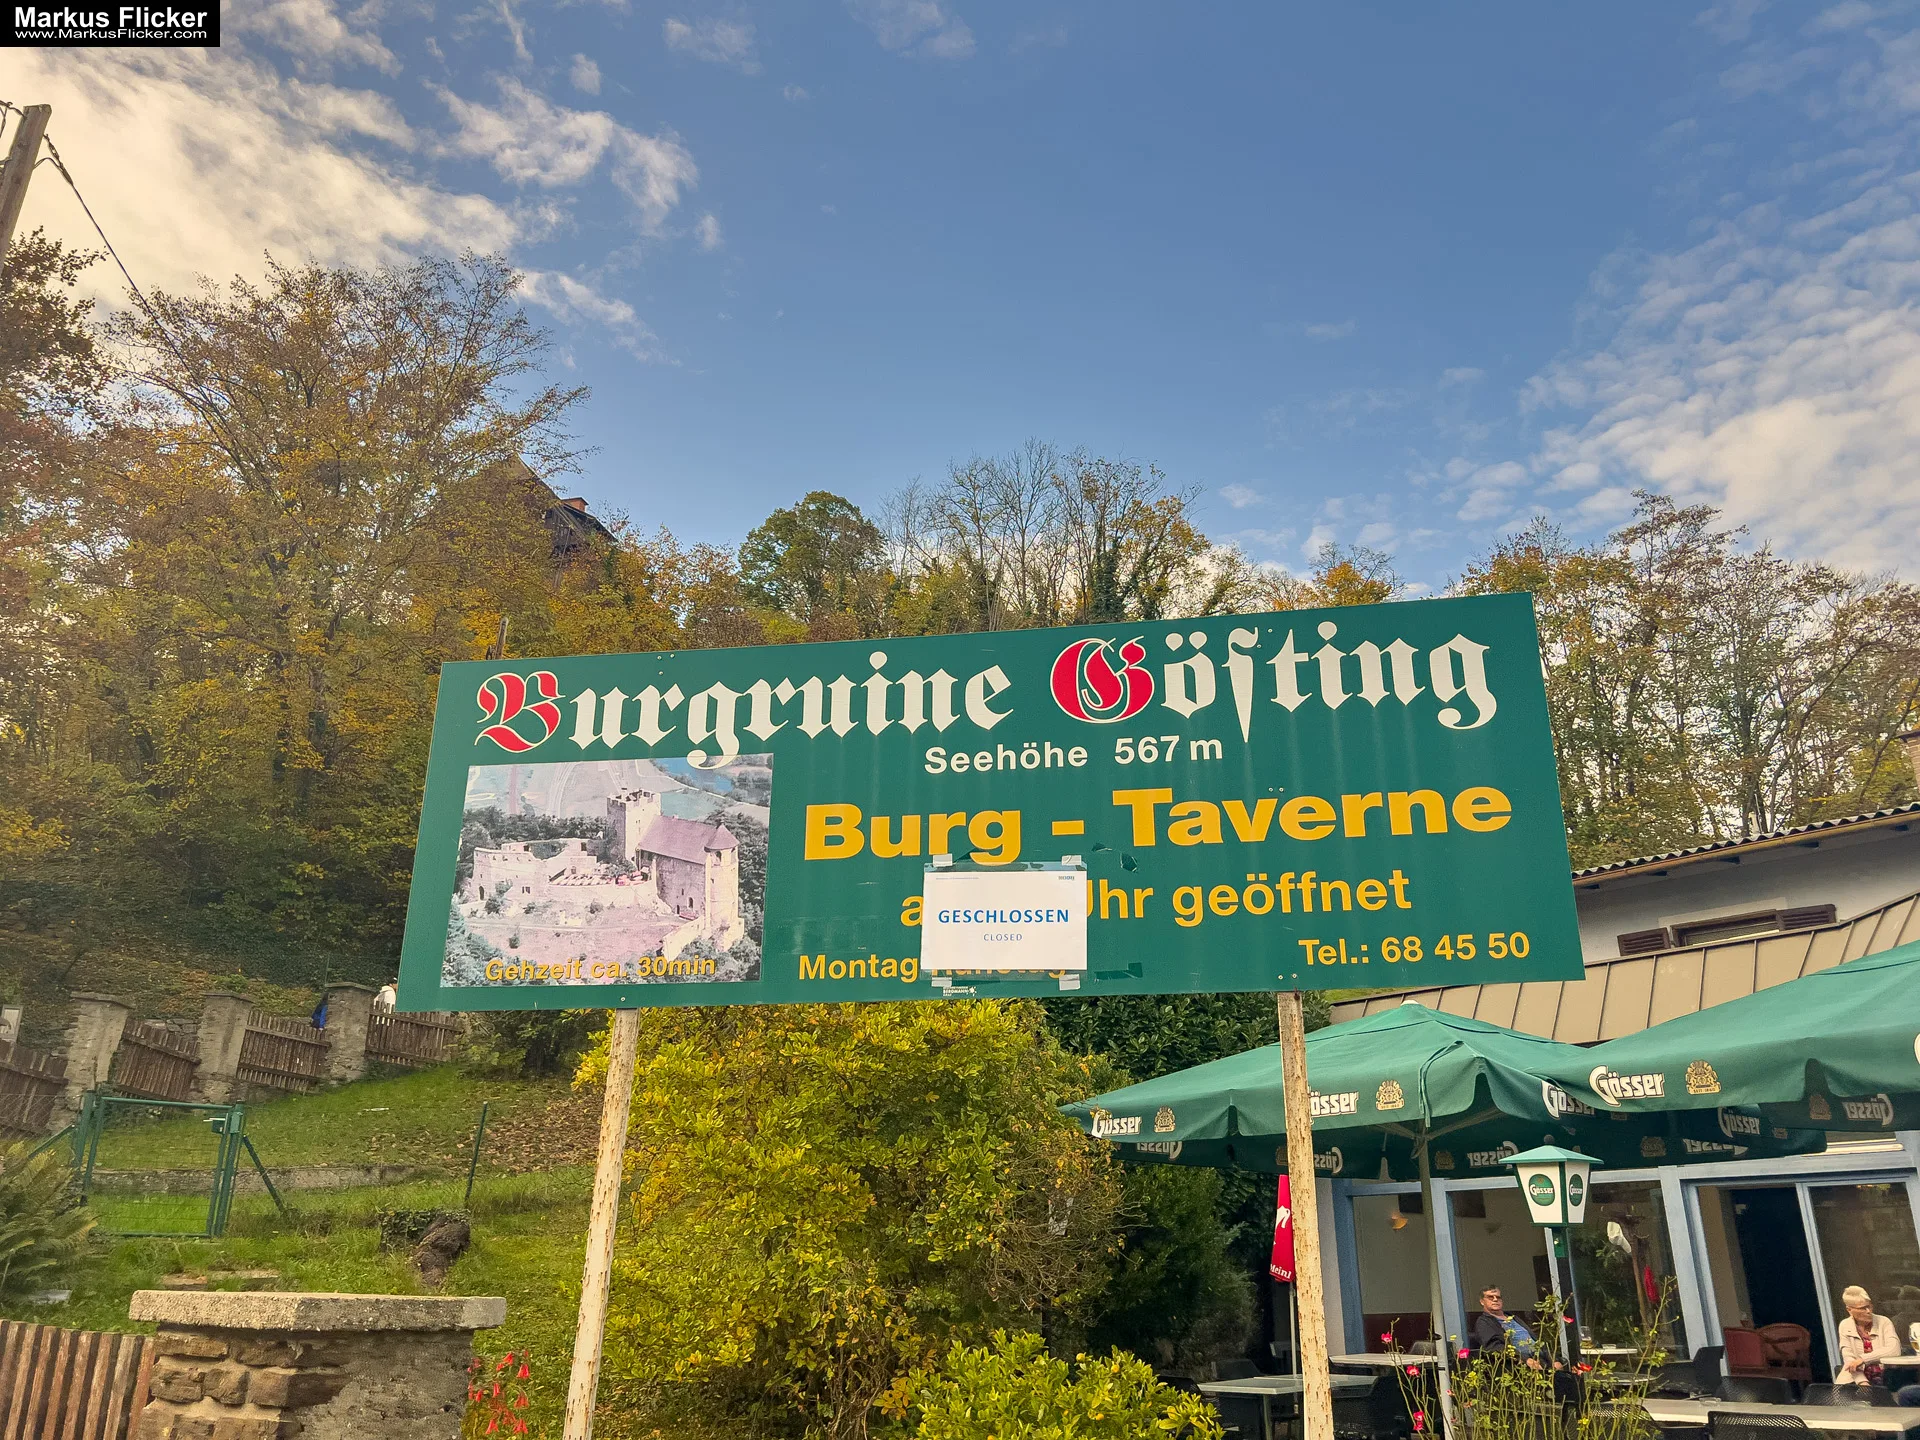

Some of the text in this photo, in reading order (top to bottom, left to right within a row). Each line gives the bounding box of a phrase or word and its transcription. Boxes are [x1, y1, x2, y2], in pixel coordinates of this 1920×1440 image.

[475, 651, 1015, 770] Burgruine
[925, 735, 1223, 774] Seehöhe 567 m
[804, 803, 1021, 867] Burg
[1113, 786, 1512, 847] Taverne
[1173, 869, 1412, 928] geöffnet
[938, 909, 1069, 924] GESCHLOSSEN
[983, 933, 1023, 942] CLOSED
[1298, 931, 1530, 965] Tel.: 68 45 50
[485, 955, 716, 981] Gehzeit ca. 30min
[799, 954, 918, 983] Montag
[1308, 1086, 1360, 1120] össer
[1590, 1065, 1665, 1107] Gösser
